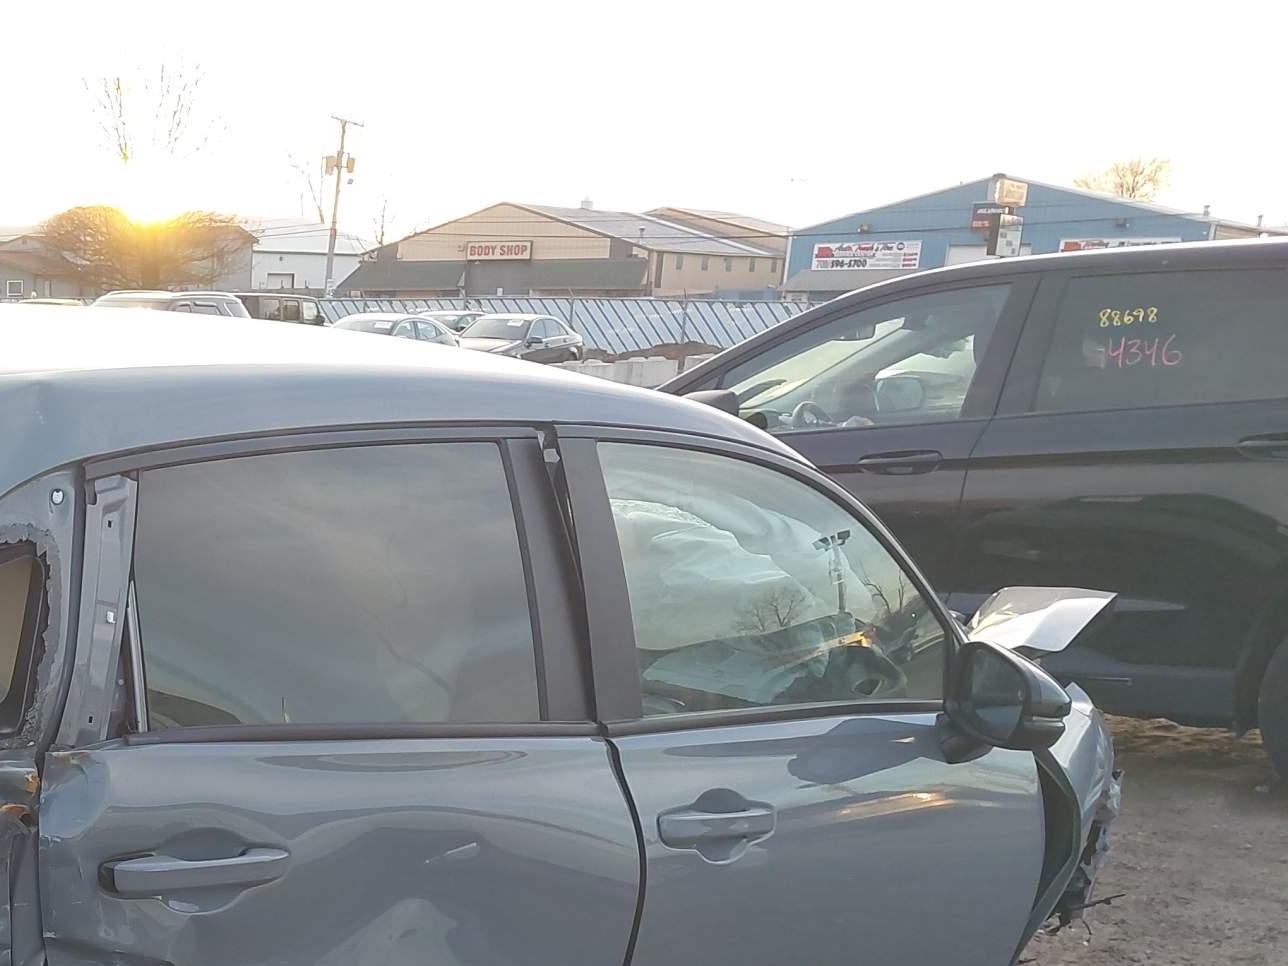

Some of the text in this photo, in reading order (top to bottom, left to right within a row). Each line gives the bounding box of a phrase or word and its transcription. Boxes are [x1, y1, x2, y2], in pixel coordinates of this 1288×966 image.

[469, 244, 528, 256] BODY SHOP
[1098, 306, 1158, 328] 88698
